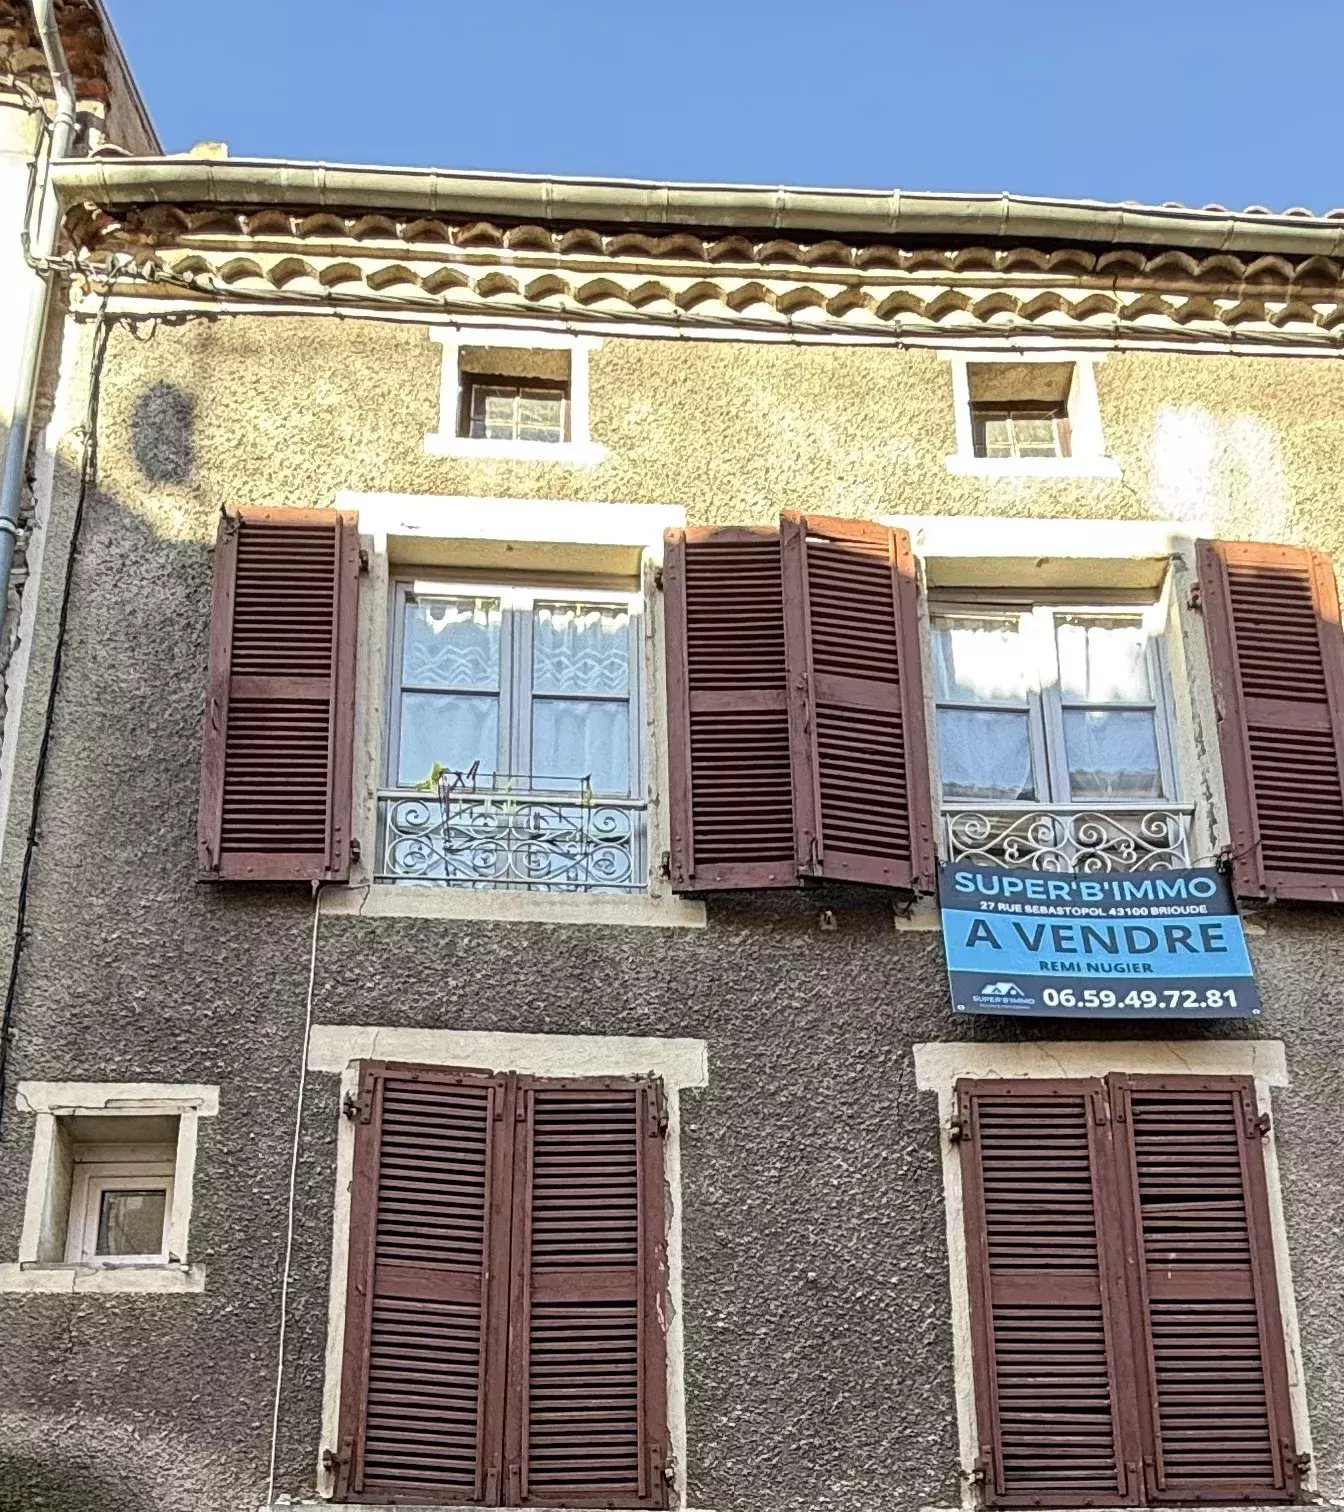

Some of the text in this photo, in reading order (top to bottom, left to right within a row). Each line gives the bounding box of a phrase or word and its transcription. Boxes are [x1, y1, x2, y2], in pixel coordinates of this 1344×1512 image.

[955, 872, 1217, 901] SUPER'B'IMMO
[980, 901, 1208, 916] 27 RUE SEBASTOPOL 43100 BRIOUDE
[966, 918, 1228, 955] A VENDRE
[1039, 960, 1154, 974] REMI NUGIER
[1043, 988, 1238, 1008] 06.59.49.72.81
